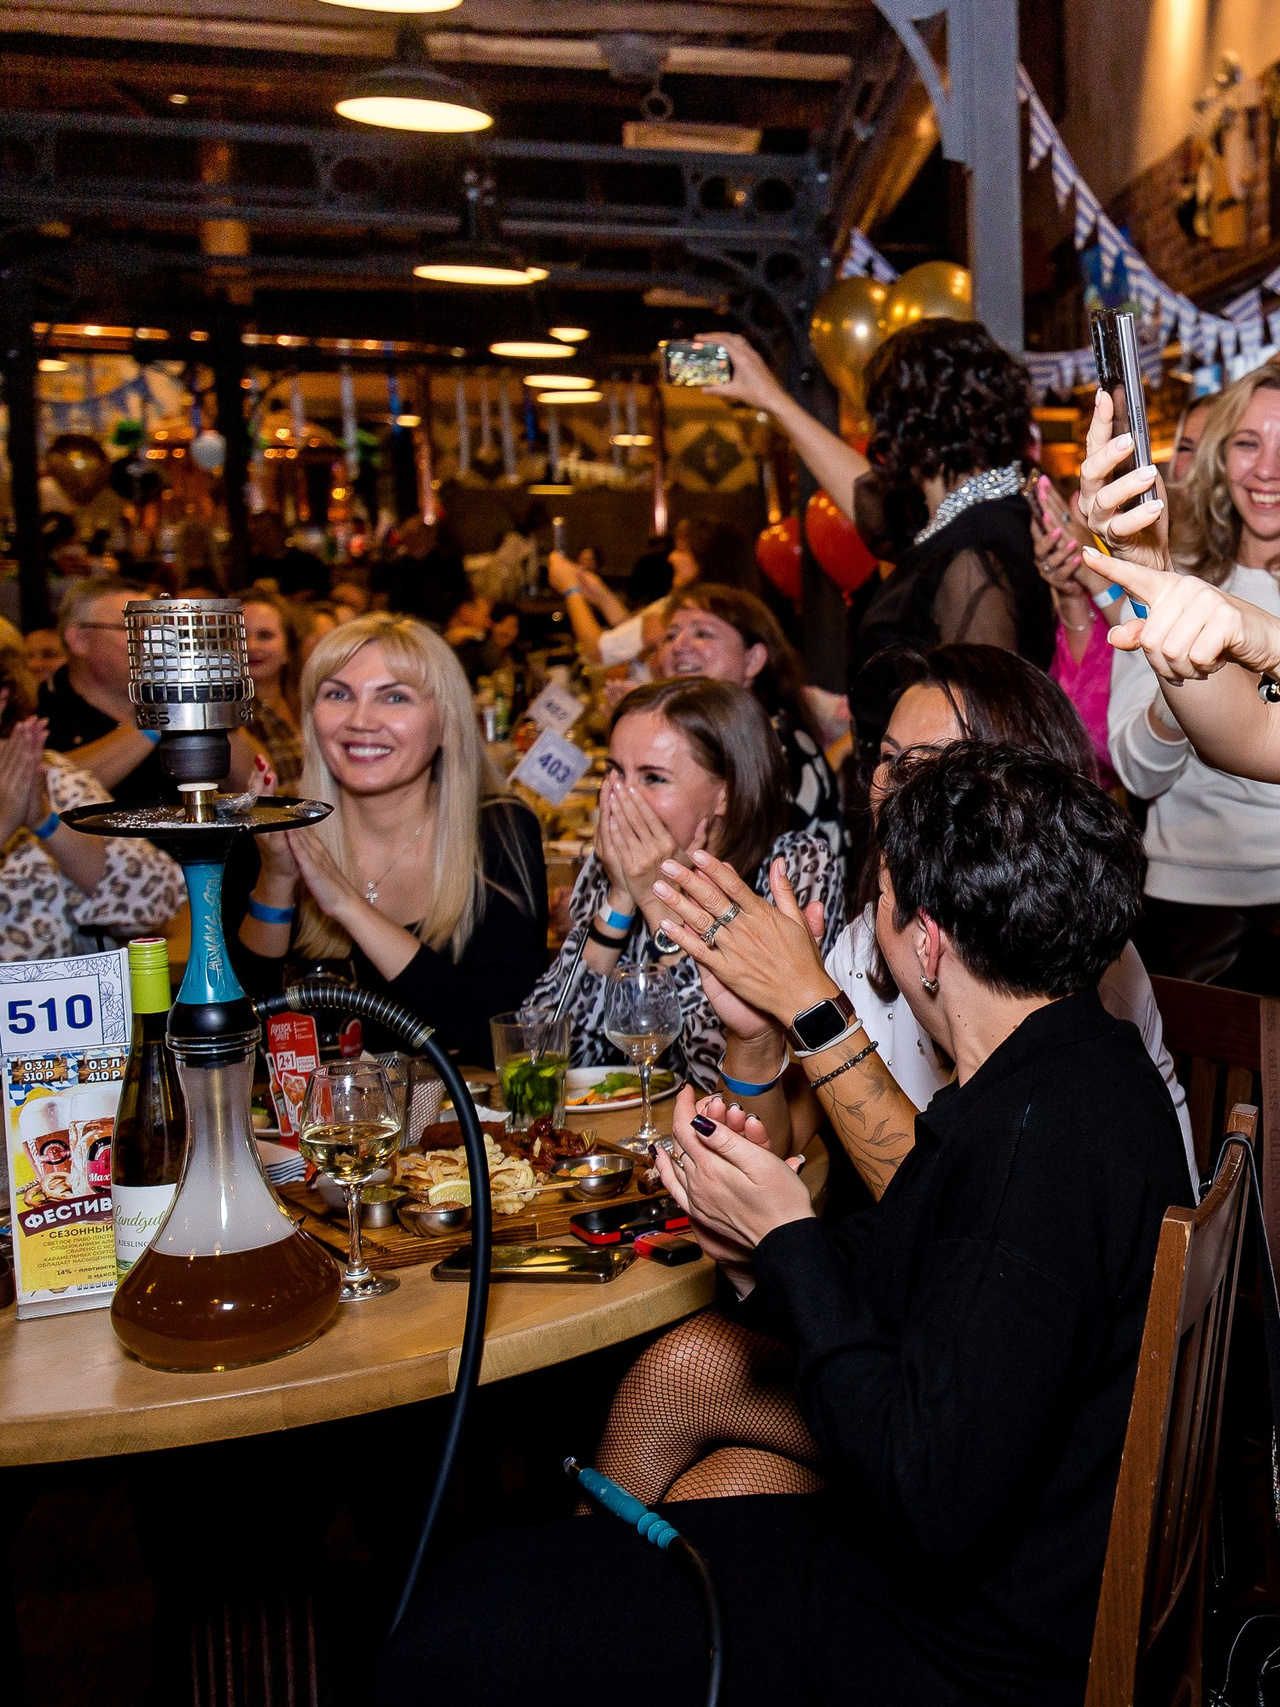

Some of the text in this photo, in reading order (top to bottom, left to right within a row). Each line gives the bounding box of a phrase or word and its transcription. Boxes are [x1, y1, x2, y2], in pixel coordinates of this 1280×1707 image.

[1135, 405, 1143, 434] SAMSUNG
[538, 752, 572, 783] 403
[7, 993, 94, 1035] 510
[24, 1061, 43, 1071] 0,3
[88, 1060, 108, 1071] 0,5
[279, 1053, 295, 1068] 2+1
[23, 1071, 44, 1082] 310
[87, 1071, 110, 1082] 410
[24, 1197, 113, 1228] ФЕСТИВ
[42, 1239, 72, 1247] СВЕТЛОЕ
[50, 1240, 101, 1251] СОДЕРЖАНИЕМ
[65, 1246, 96, 1255] СВАРЕНО
